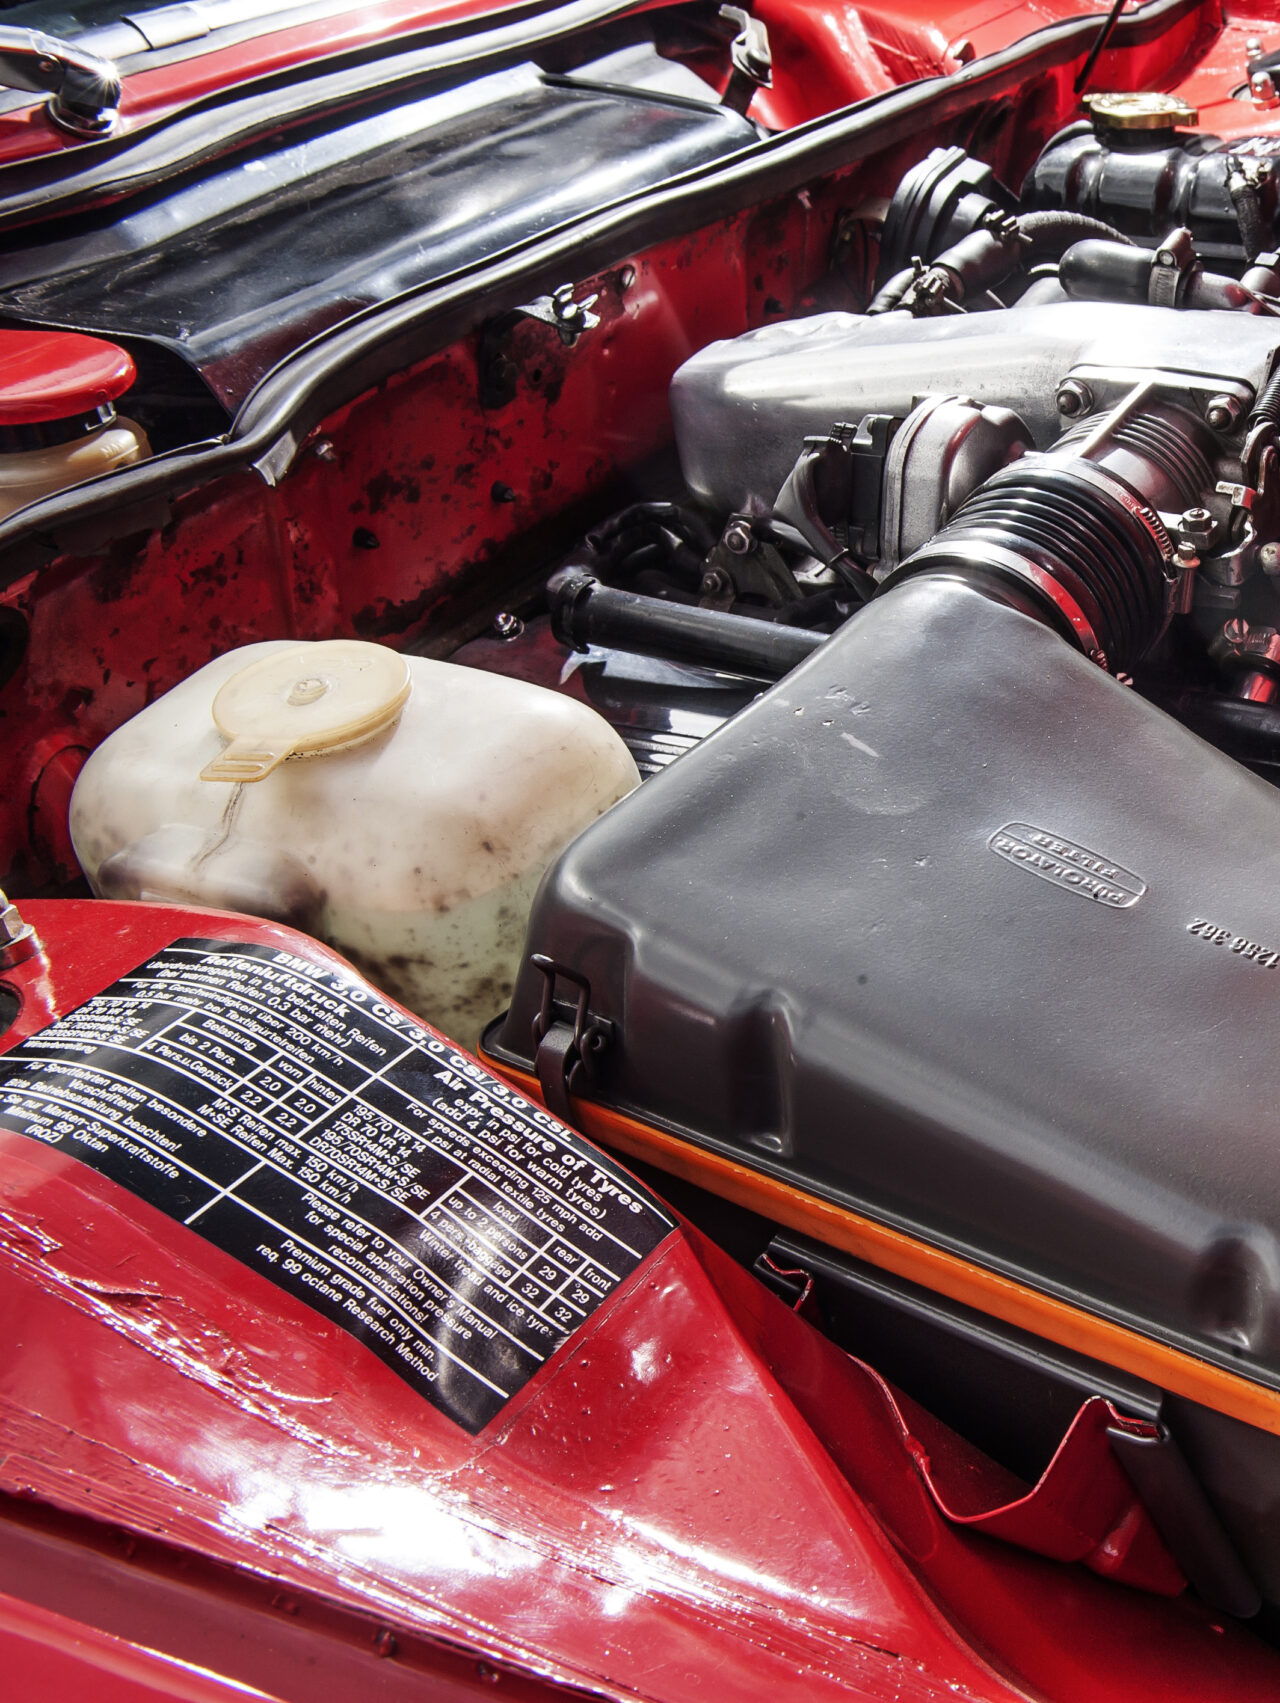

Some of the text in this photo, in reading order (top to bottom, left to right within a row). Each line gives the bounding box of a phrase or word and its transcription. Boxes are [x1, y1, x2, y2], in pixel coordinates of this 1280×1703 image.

[996, 836, 1128, 905] PUROLATOR
[1032, 832, 1121, 881] FILTER
[1186, 917, 1232, 946] 362
[200, 955, 350, 1018] Reifenluftdruck
[226, 981, 352, 1049] Reifen 0,3 bar mehr)
[262, 983, 387, 1057] bar Reifen
[179, 1033, 316, 1114] bis 2 Pers. 2,0 2,0
[202, 1019, 343, 1103] Belastung vorn hinten
[204, 1002, 315, 1064] bei Textilgürtelreifen
[257, 1012, 344, 1067] über 200 km/h
[272, 953, 573, 1142] BMW 3,0 CS/3,0 CSi/3,0 CSL
[67, 1079, 139, 1112] Vorschriften!
[109, 1080, 207, 1137] gelten besondere
[145, 1042, 297, 1128] 4 Pers.u.Gepäck 2,2 2,2
[3, 1106, 109, 1152] Minimum 99 Oktan
[24, 1125, 64, 1143] (ROZ)
[43, 1105, 180, 1179] Marken-Superkraftstoffe
[123, 1117, 182, 1152] beachten!
[197, 1104, 351, 1204] M+SE Reifen Max. 150 km/h
[212, 1098, 359, 1193] M+S Reifen max. 150 km/h
[340, 1112, 411, 1158] DR 70 VR 14
[353, 1104, 426, 1153] 195/70 VR 14
[432, 1097, 607, 1220] (add 4 psi for warm tyres)
[434, 1070, 644, 1213] Air Pressure of Tyres
[454, 1098, 602, 1202] expr. in psi for cold tyres
[406, 1102, 603, 1242] For speeds exceeding 125 mph add
[422, 1127, 565, 1232] 7 psi at radial textile tyres
[301, 1192, 498, 1341] Please refer to your Owner's Manual
[304, 1210, 472, 1340] for special application pressure
[327, 1243, 429, 1323] recommendations!
[419, 1229, 524, 1318] Winter tread and ice
[430, 1210, 572, 1322] 4 32 32
[448, 1196, 590, 1304] up to 2 persons 29 29
[493, 1201, 613, 1291] load rear front
[256, 1244, 440, 1382] req. 99 octane Research Method
[280, 1239, 436, 1362] Premium grade fuel only min.
